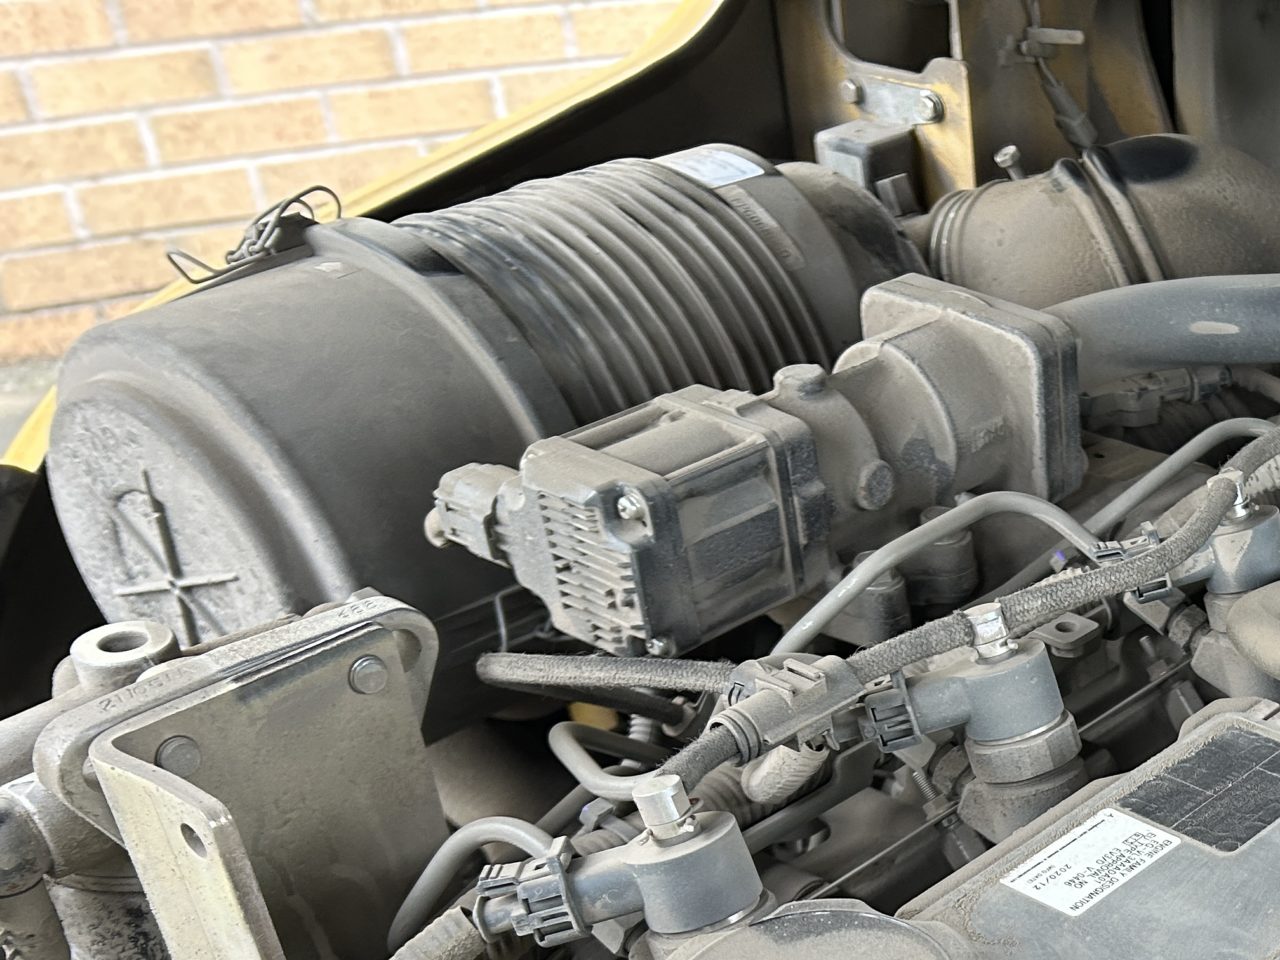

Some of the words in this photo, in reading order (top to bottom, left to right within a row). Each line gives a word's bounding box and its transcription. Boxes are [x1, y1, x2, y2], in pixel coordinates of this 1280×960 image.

[1122, 840, 1144, 854] TYPE
[1143, 838, 1173, 858] ENGINE
[1031, 863, 1072, 891] 2020/12
[1086, 852, 1126, 879] APPROVAL
[1116, 857, 1146, 877] FAMILY
[1068, 876, 1120, 911] DESIGNATION
